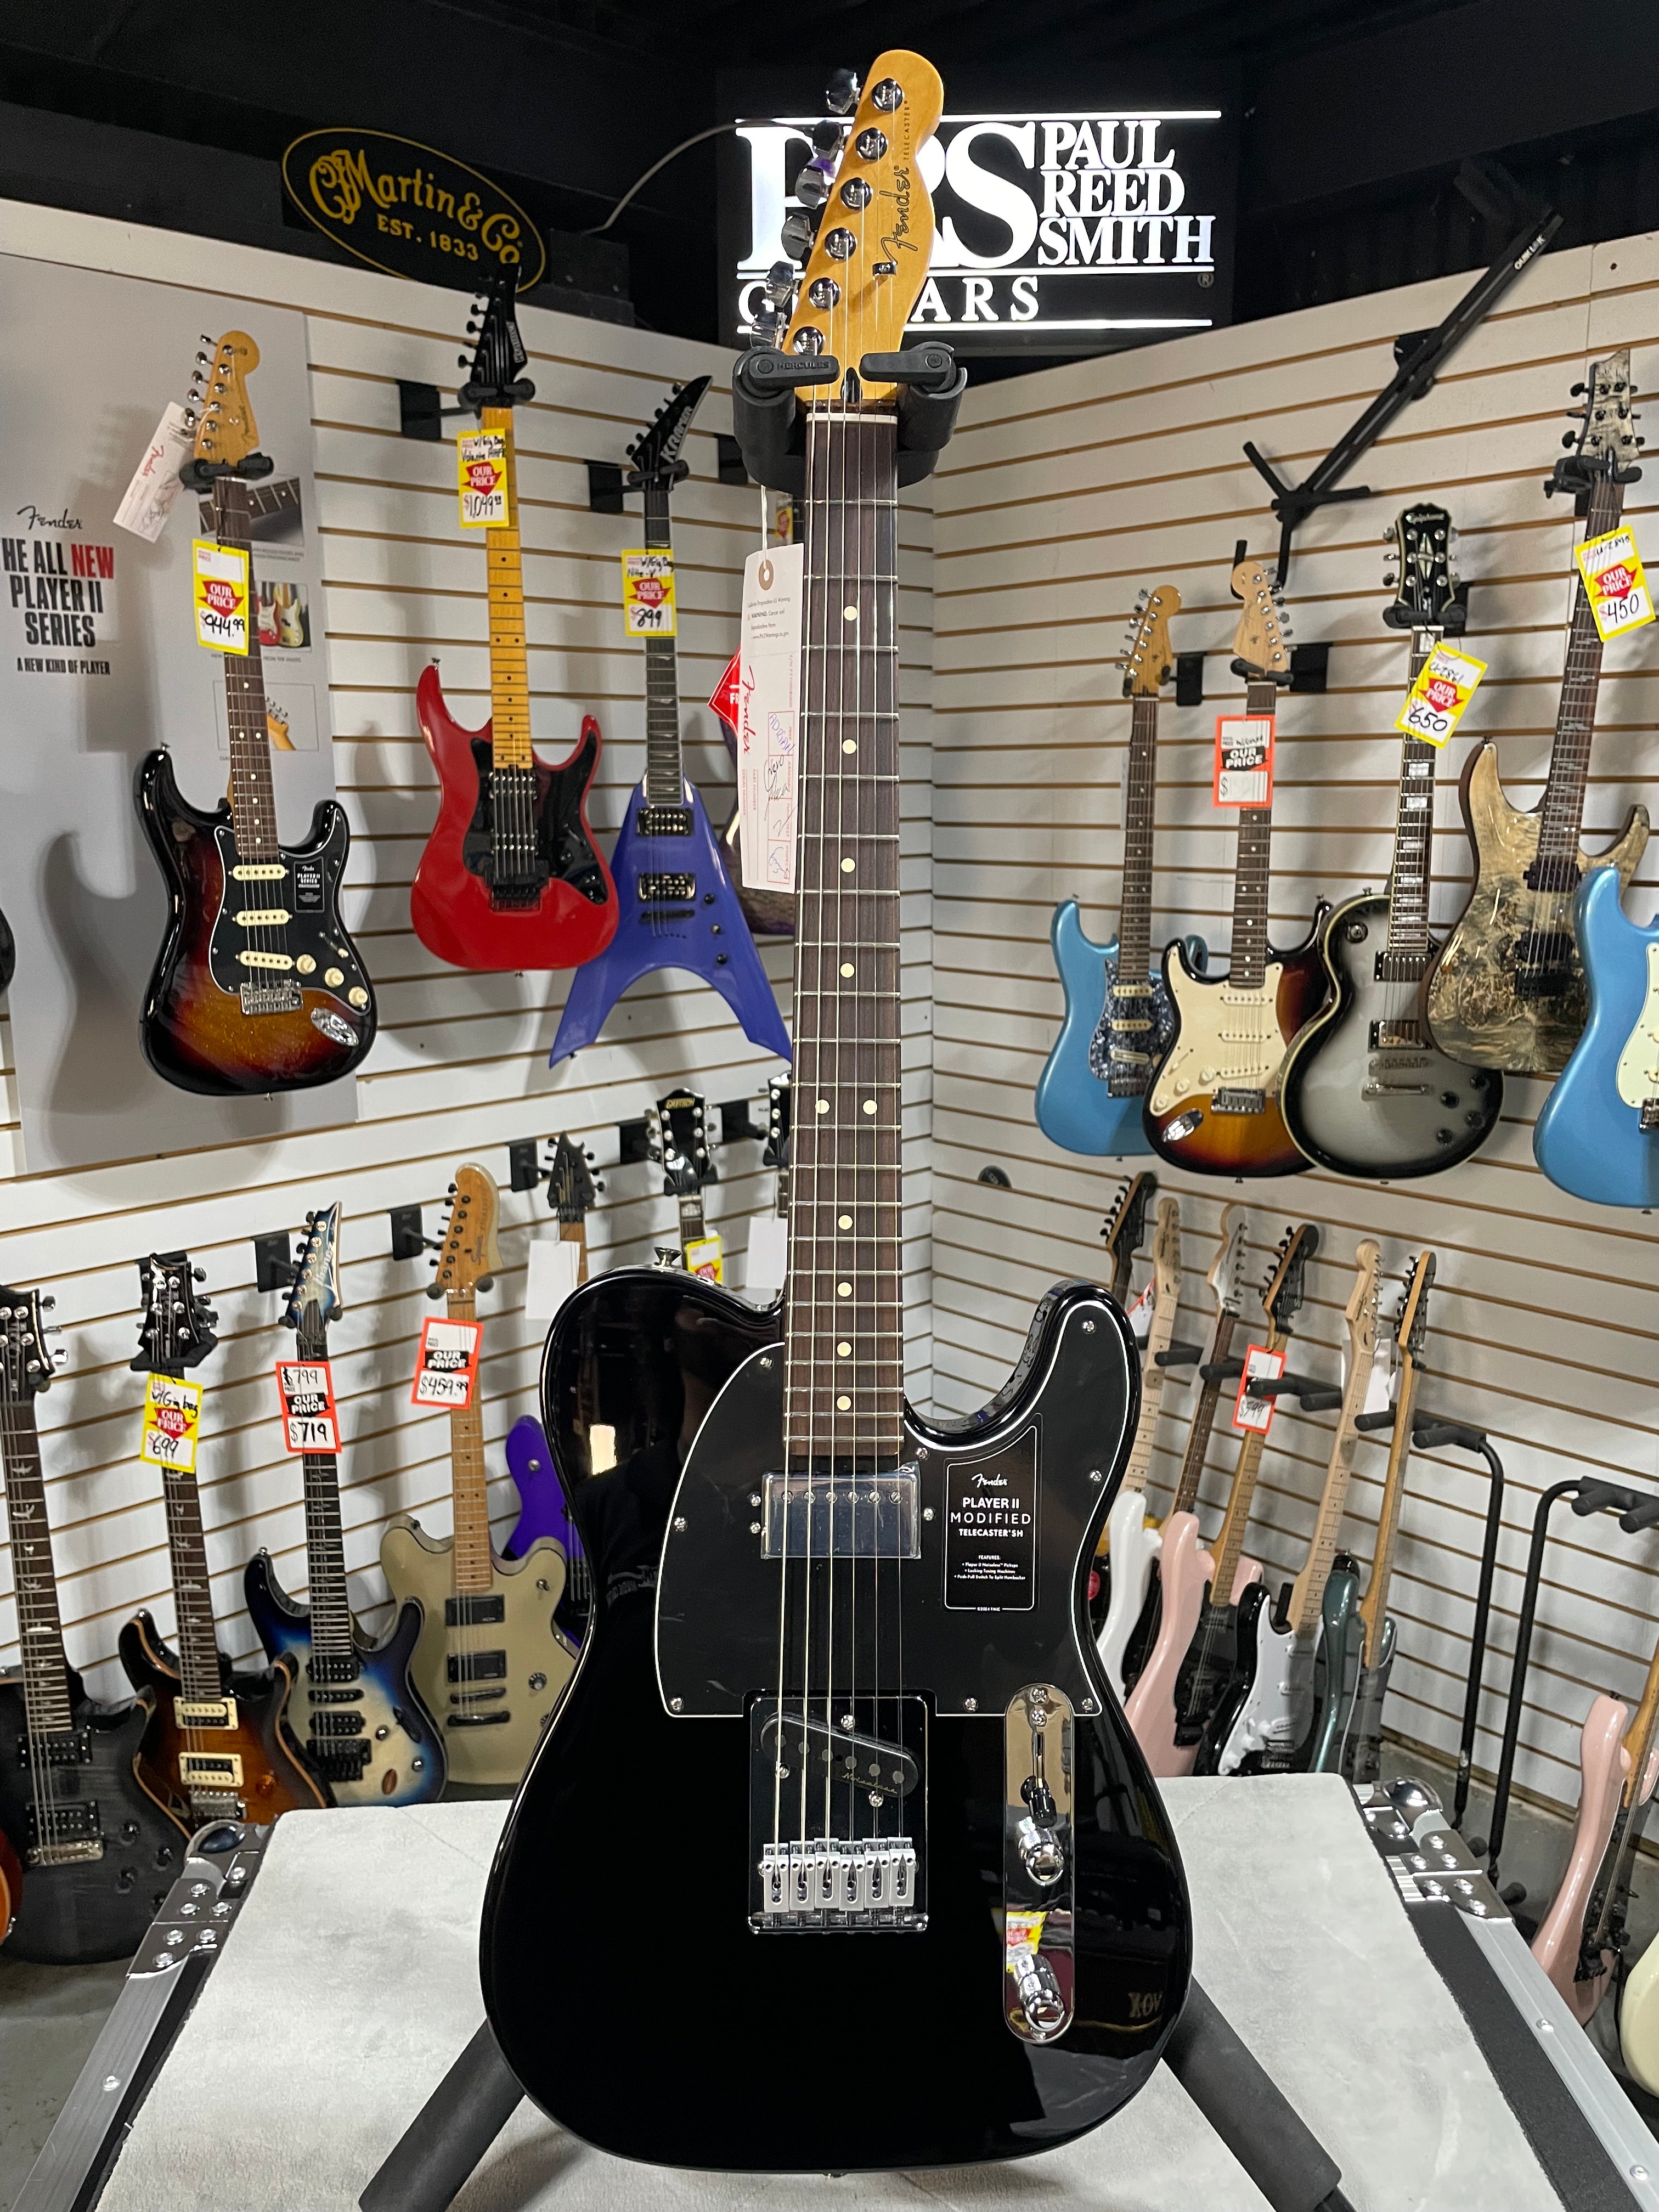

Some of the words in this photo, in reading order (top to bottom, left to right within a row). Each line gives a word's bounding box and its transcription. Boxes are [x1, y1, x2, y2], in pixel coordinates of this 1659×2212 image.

[1040, 120, 1174, 170] PAUL
[1040, 170, 1184, 217] REED
[377, 213, 421, 242] EST.
[430, 231, 479, 262] 1833
[1037, 216, 1216, 266] SMITH
[777, 360, 831, 370] HERCULES
[472, 466, 493, 476] OUR
[470, 475, 496, 488] PRICE
[17, 505, 82, 530] Fender
[33, 540, 68, 575] ALL
[71, 543, 114, 579] NEW
[1603, 566, 1628, 585] OUR
[210, 583, 232, 598] OUR
[639, 582, 661, 591] OUR
[1602, 574, 1633, 596] PRICE
[10, 574, 85, 612] PLAYER
[88, 580, 103, 613] II
[636, 590, 665, 600] PRICE
[207, 594, 236, 610] PRICE
[25, 612, 96, 647] SERIES
[17, 657, 23, 672] A
[24, 658, 43, 673] NEW
[45, 659, 66, 675] KIND
[68, 659, 78, 674] OF
[80, 661, 111, 675] PLAYER
[1434, 681, 1456, 697] OUR
[1426, 688, 1457, 708] PRICE
[742, 665, 755, 755] Fender
[1226, 754, 1263, 769] PRICE
[1229, 748, 1257, 759] OUR
[427, 1358, 466, 1369] PRICE
[433, 1351, 461, 1360] OUR
[294, 1394, 319, 1405] OUR
[291, 1401, 326, 1415] PRICE
[161, 1409, 184, 1424] OUR
[157, 1418, 188, 1434] PRICE
[290, 1421, 328, 1443] $719
[971, 1473, 1008, 1488] Fender
[963, 1497, 1009, 1509] PLAYER
[1012, 1498, 1019, 1509] II
[951, 1512, 1031, 1525] MODIFIED
